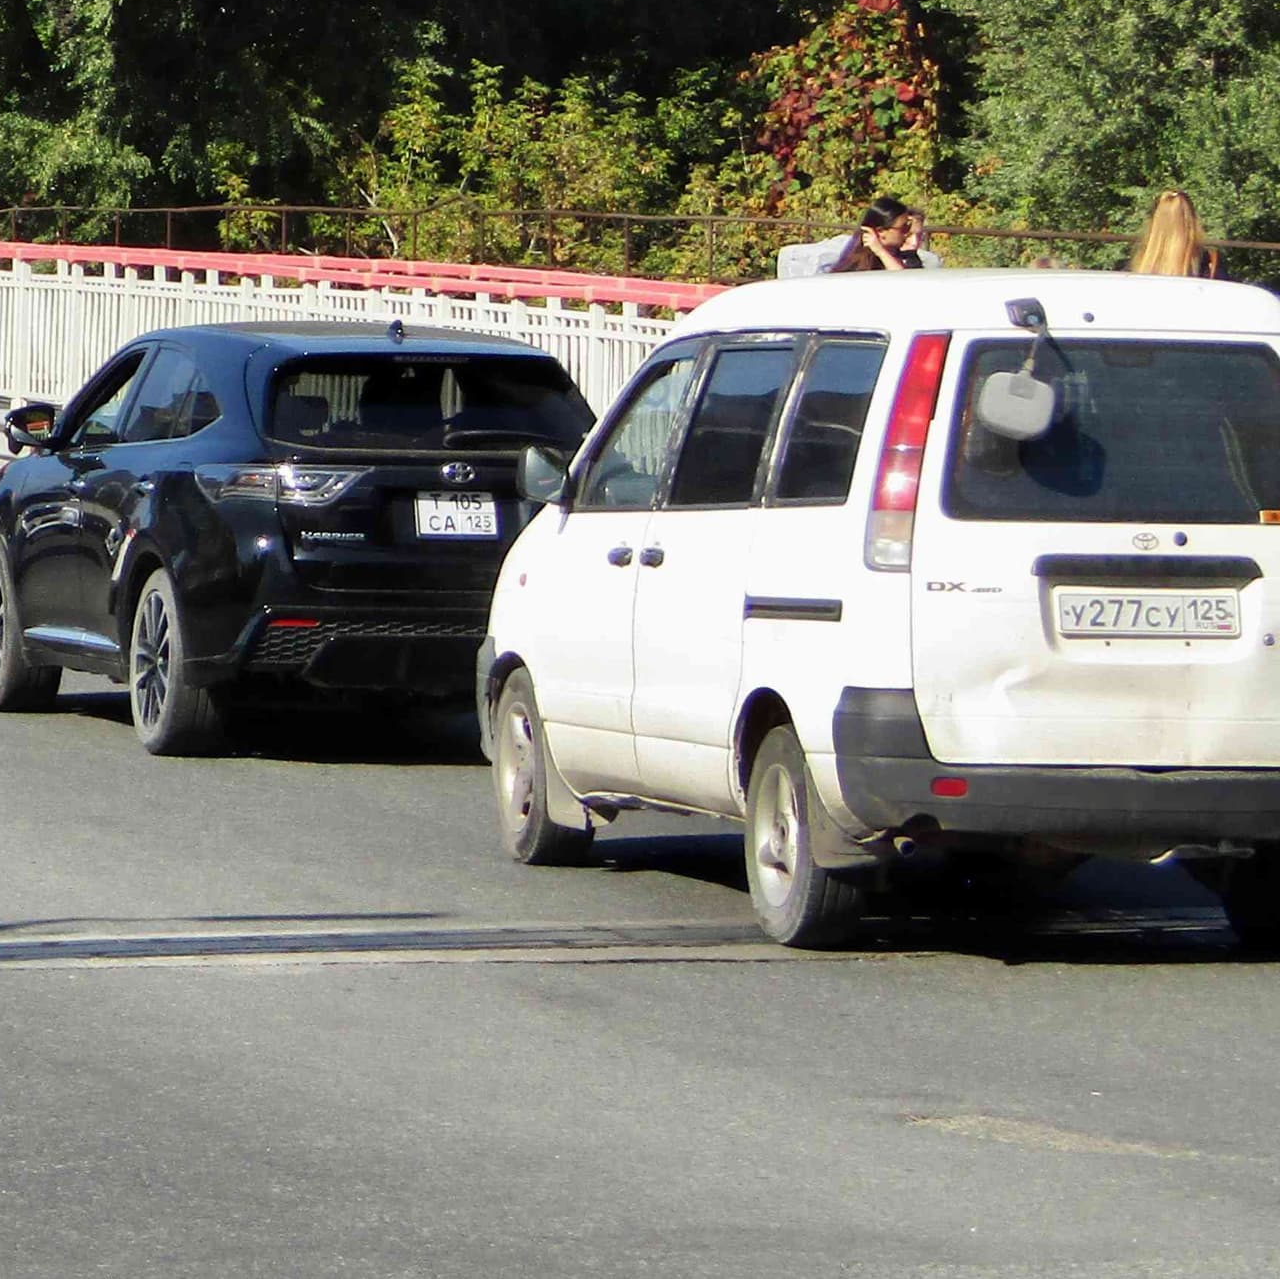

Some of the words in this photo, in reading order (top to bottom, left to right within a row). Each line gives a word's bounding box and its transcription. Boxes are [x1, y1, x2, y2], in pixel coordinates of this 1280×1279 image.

[448, 493, 483, 511] 105
[466, 515, 492, 529] 125
[926, 581, 967, 593] DX
[1186, 598, 1228, 621] 125
